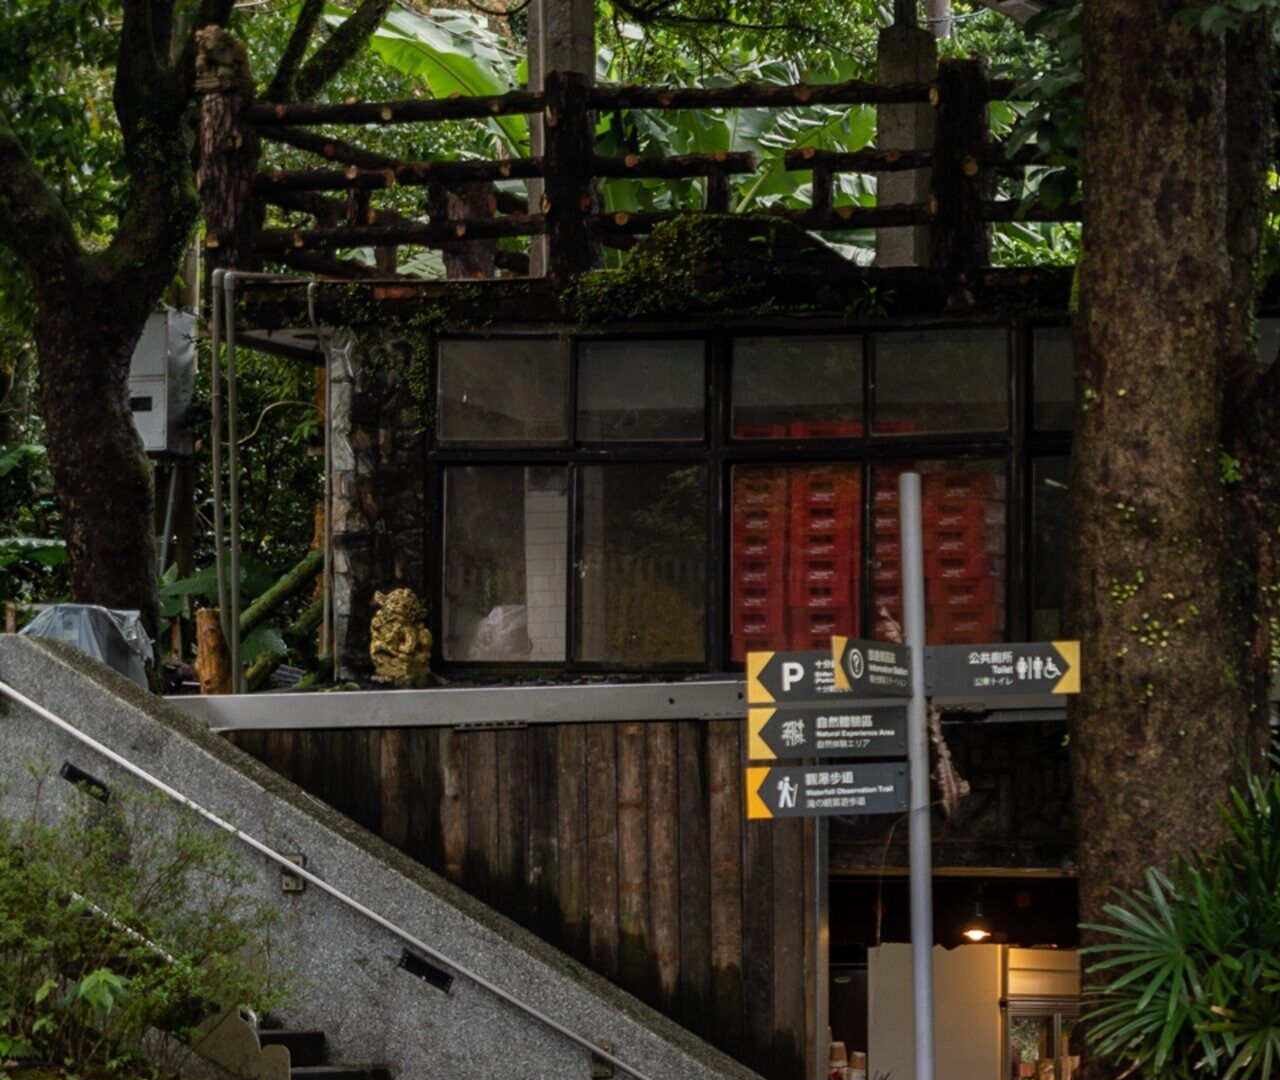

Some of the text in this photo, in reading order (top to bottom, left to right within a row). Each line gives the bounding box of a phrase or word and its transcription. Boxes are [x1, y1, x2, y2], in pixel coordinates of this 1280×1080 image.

[992, 665, 1013, 674] Toilet
[782, 662, 804, 691] P
[842, 730, 878, 738] Experience
[805, 788, 835, 796] Waterfall
[836, 787, 878, 795] Observation
